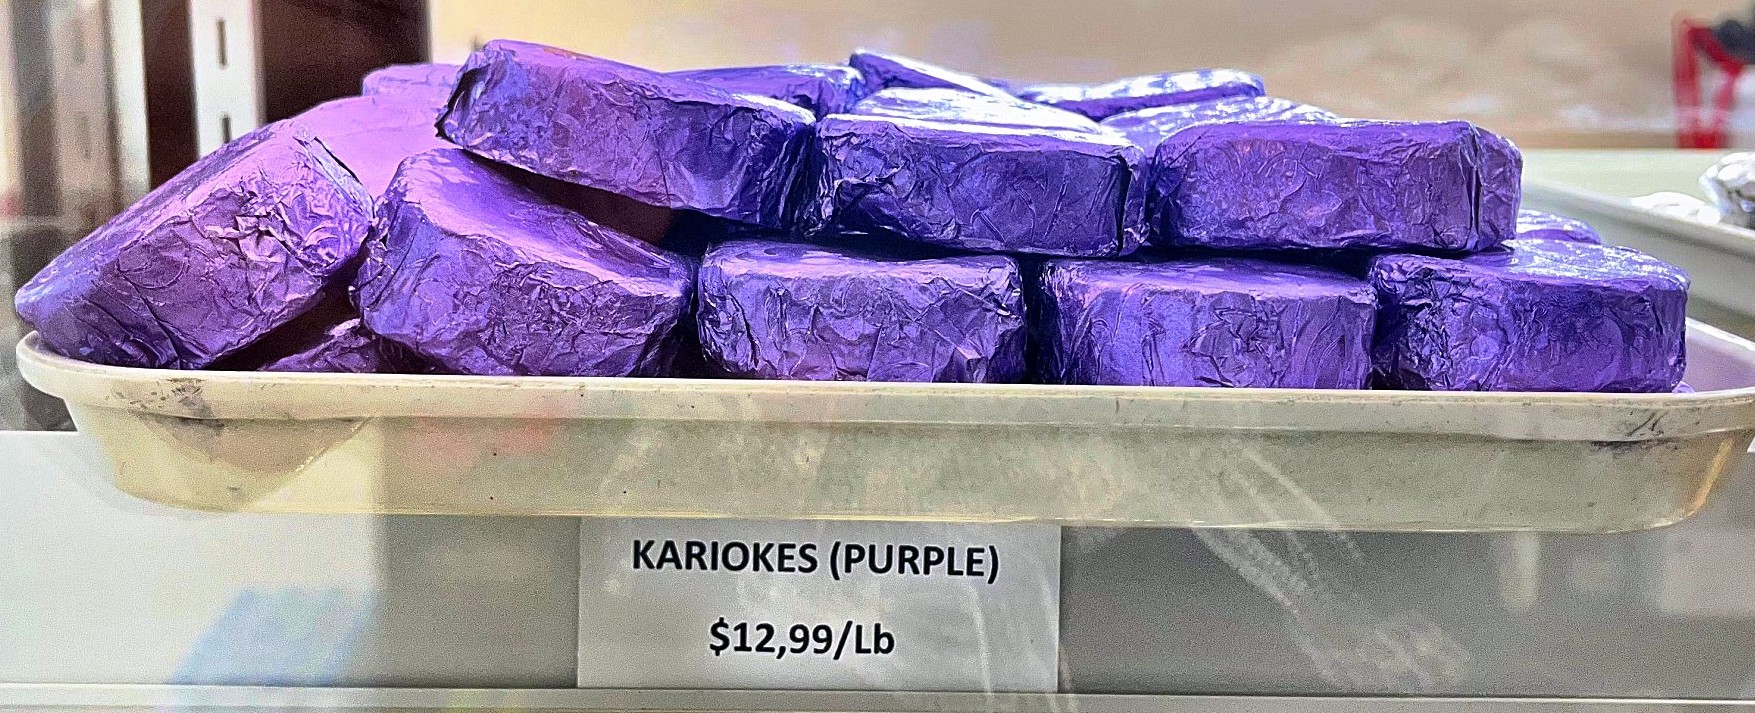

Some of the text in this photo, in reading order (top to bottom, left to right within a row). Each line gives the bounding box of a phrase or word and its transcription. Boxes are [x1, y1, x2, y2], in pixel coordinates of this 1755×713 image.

[633, 539, 999, 585] KARIOKES (PURPLE)
[709, 616, 895, 661] $12,99/Lb
